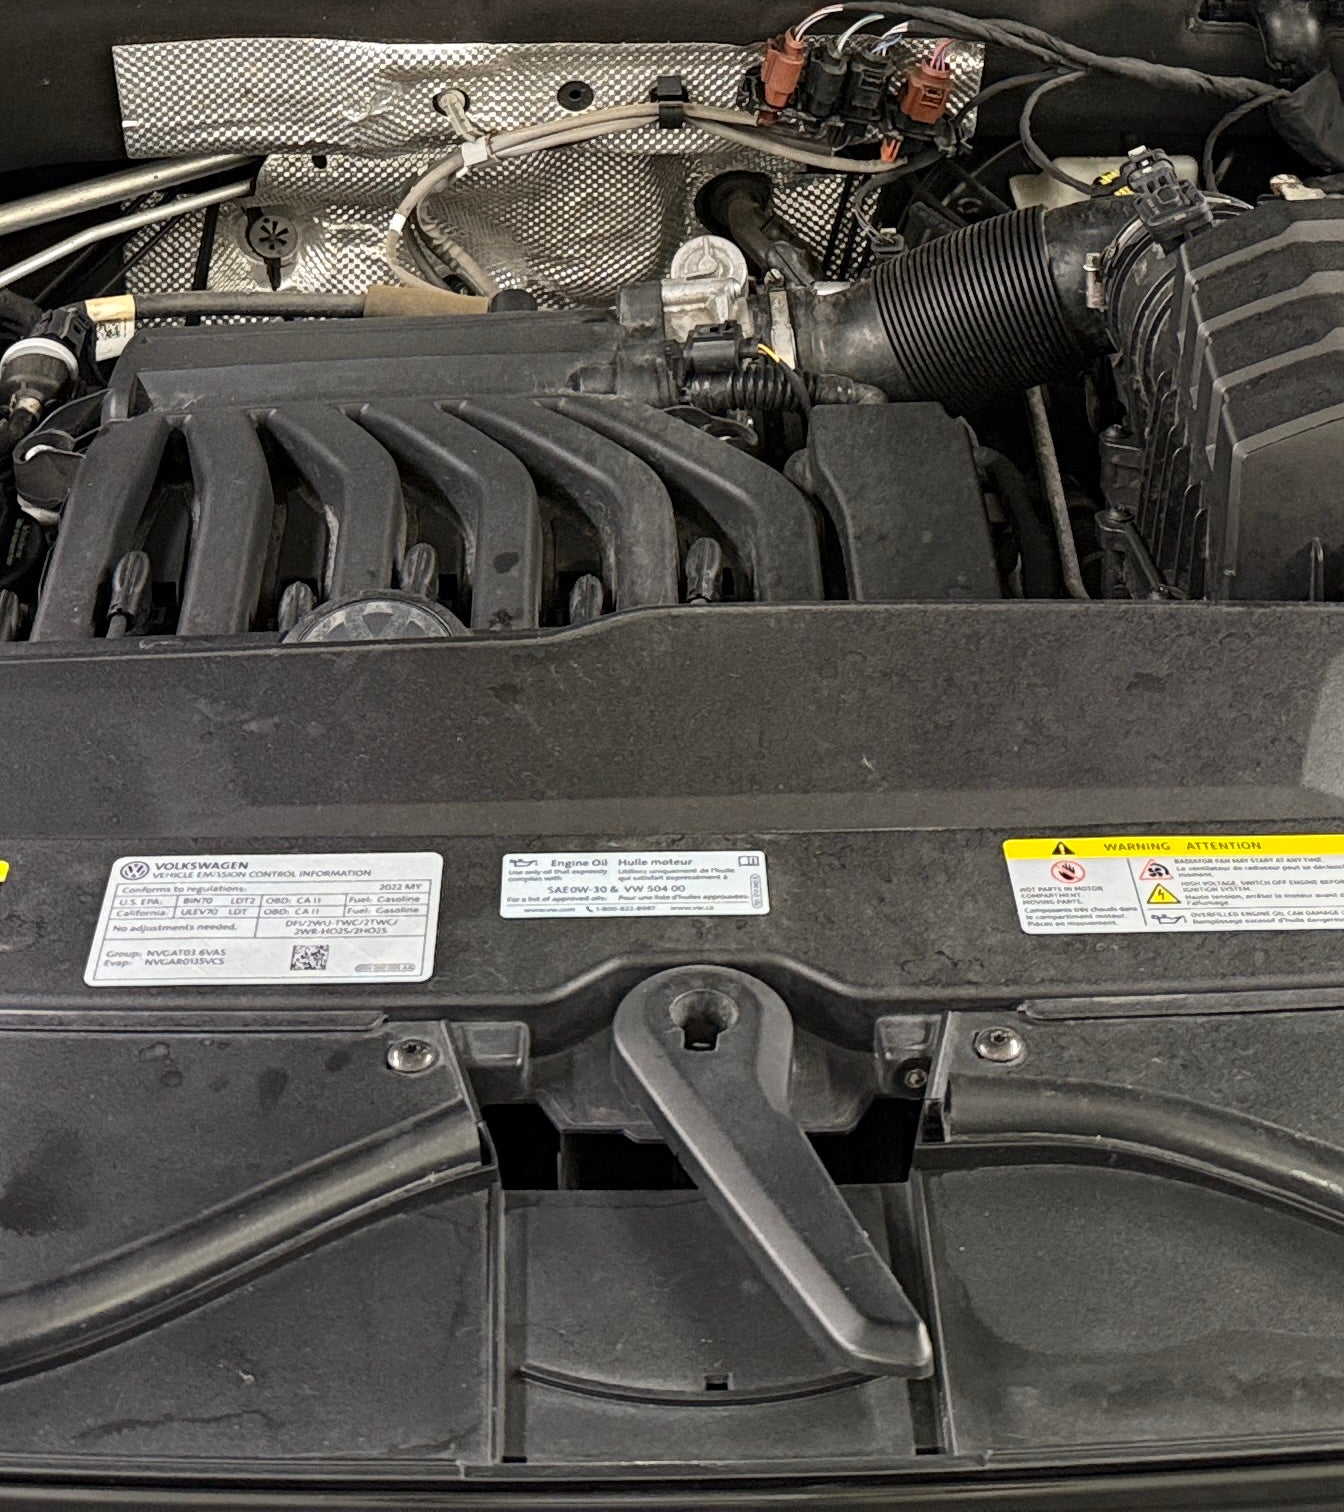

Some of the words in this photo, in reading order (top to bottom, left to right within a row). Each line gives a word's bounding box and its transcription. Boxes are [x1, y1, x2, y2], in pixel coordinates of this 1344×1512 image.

[1104, 842, 1171, 851] WARNING
[1186, 841, 1262, 850] ATTENTION
[156, 861, 249, 871] VOLKSWAGEN
[551, 859, 589, 868] Engine
[592, 858, 608, 867] Oil
[618, 858, 648, 866] Huile
[651, 858, 693, 866] moteur
[153, 871, 193, 879] VEHICLE
[197, 871, 246, 879] EMISSION
[249, 870, 296, 878] CONTROL
[299, 869, 372, 877] INFORMATION
[186, 886, 247, 894] regulations:
[405, 883, 423, 891] MY
[624, 885, 644, 893] VW
[647, 885, 668, 893] 504
[119, 898, 137, 906] U.S.
[230, 897, 256, 905] LDT2
[228, 908, 249, 916] LDT
[347, 907, 371, 915] Fuel:
[376, 907, 419, 915] Gasoline
[130, 923, 194, 934] adjustments
[196, 923, 238, 931] needed.
[106, 950, 143, 959] Group:
[104, 959, 131, 968] Evap:
